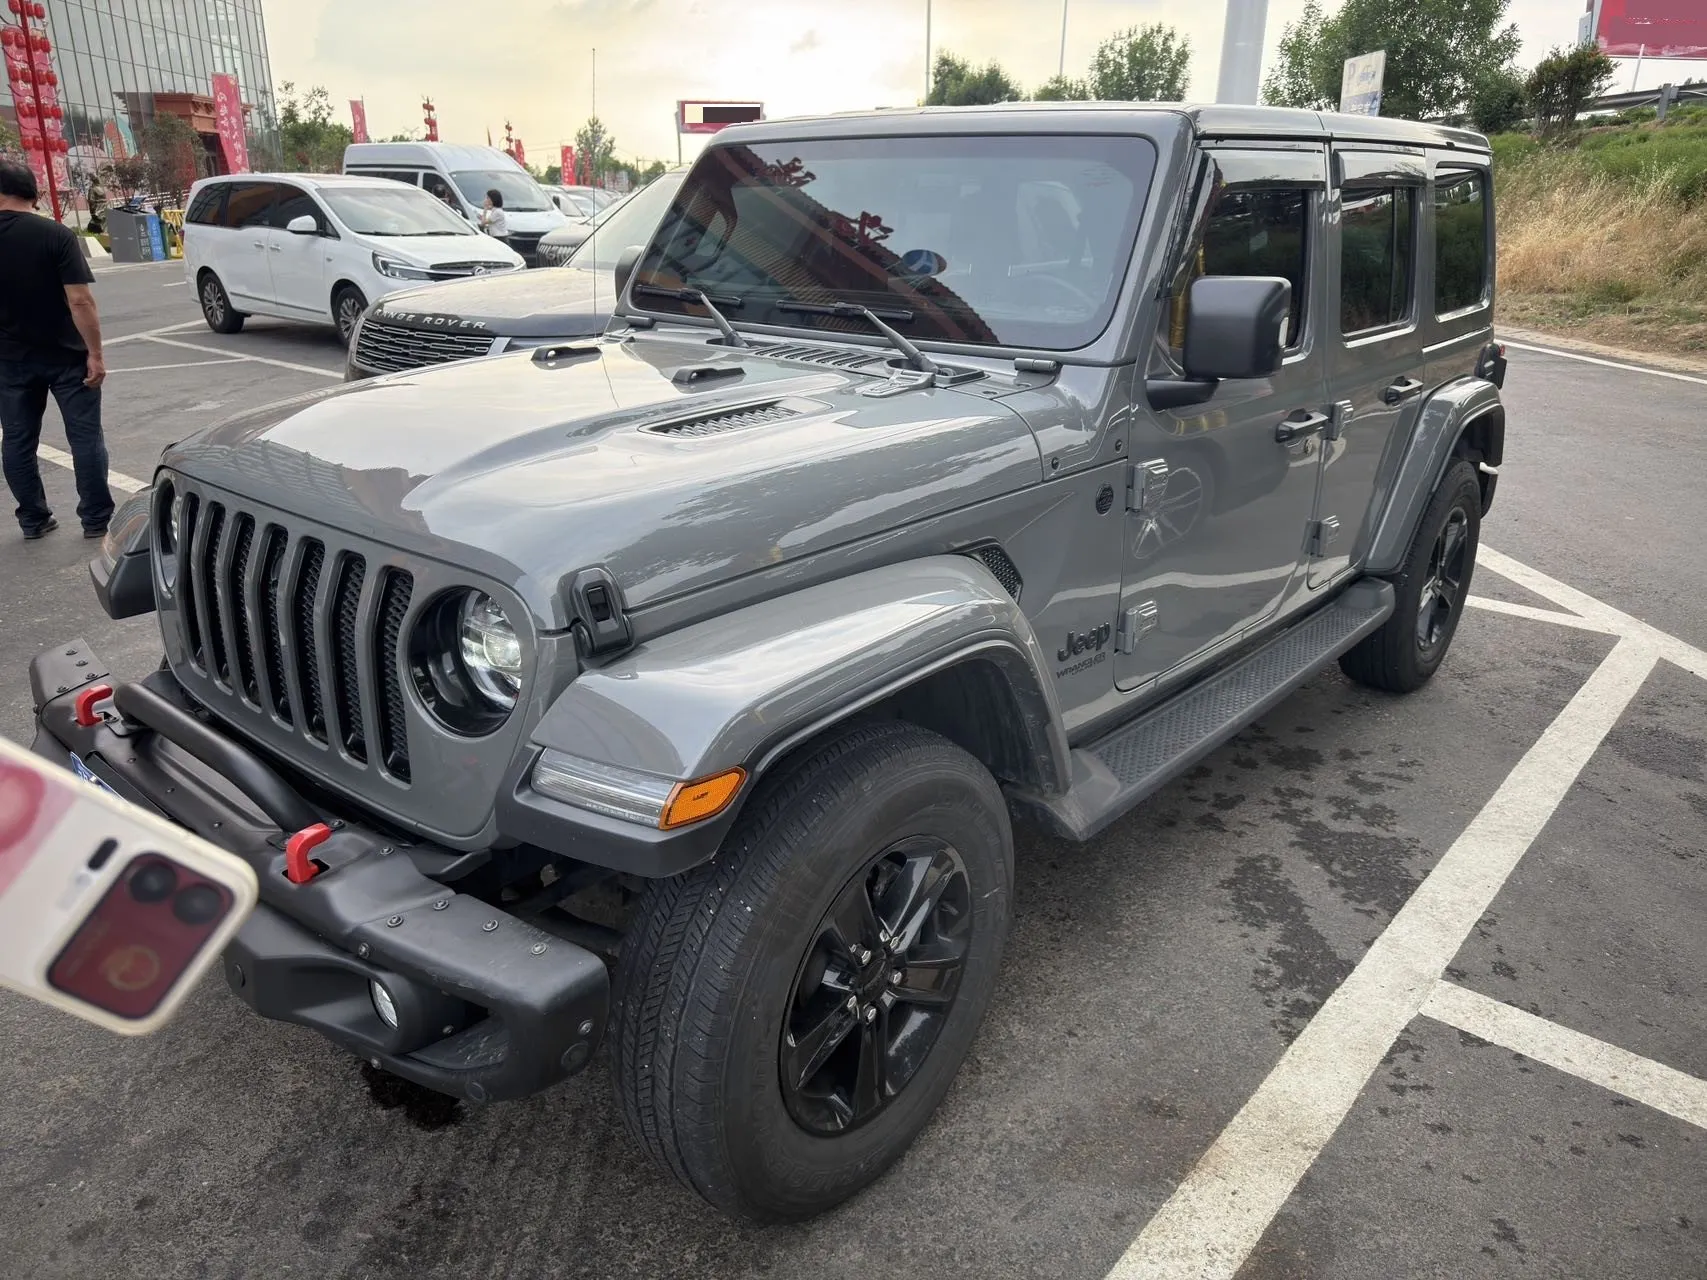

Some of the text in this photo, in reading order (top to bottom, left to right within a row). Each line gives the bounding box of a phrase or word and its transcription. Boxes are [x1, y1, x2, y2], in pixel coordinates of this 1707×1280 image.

[374, 308, 486, 329] RANGE ROVER
[1057, 622, 1110, 662] Jeep
